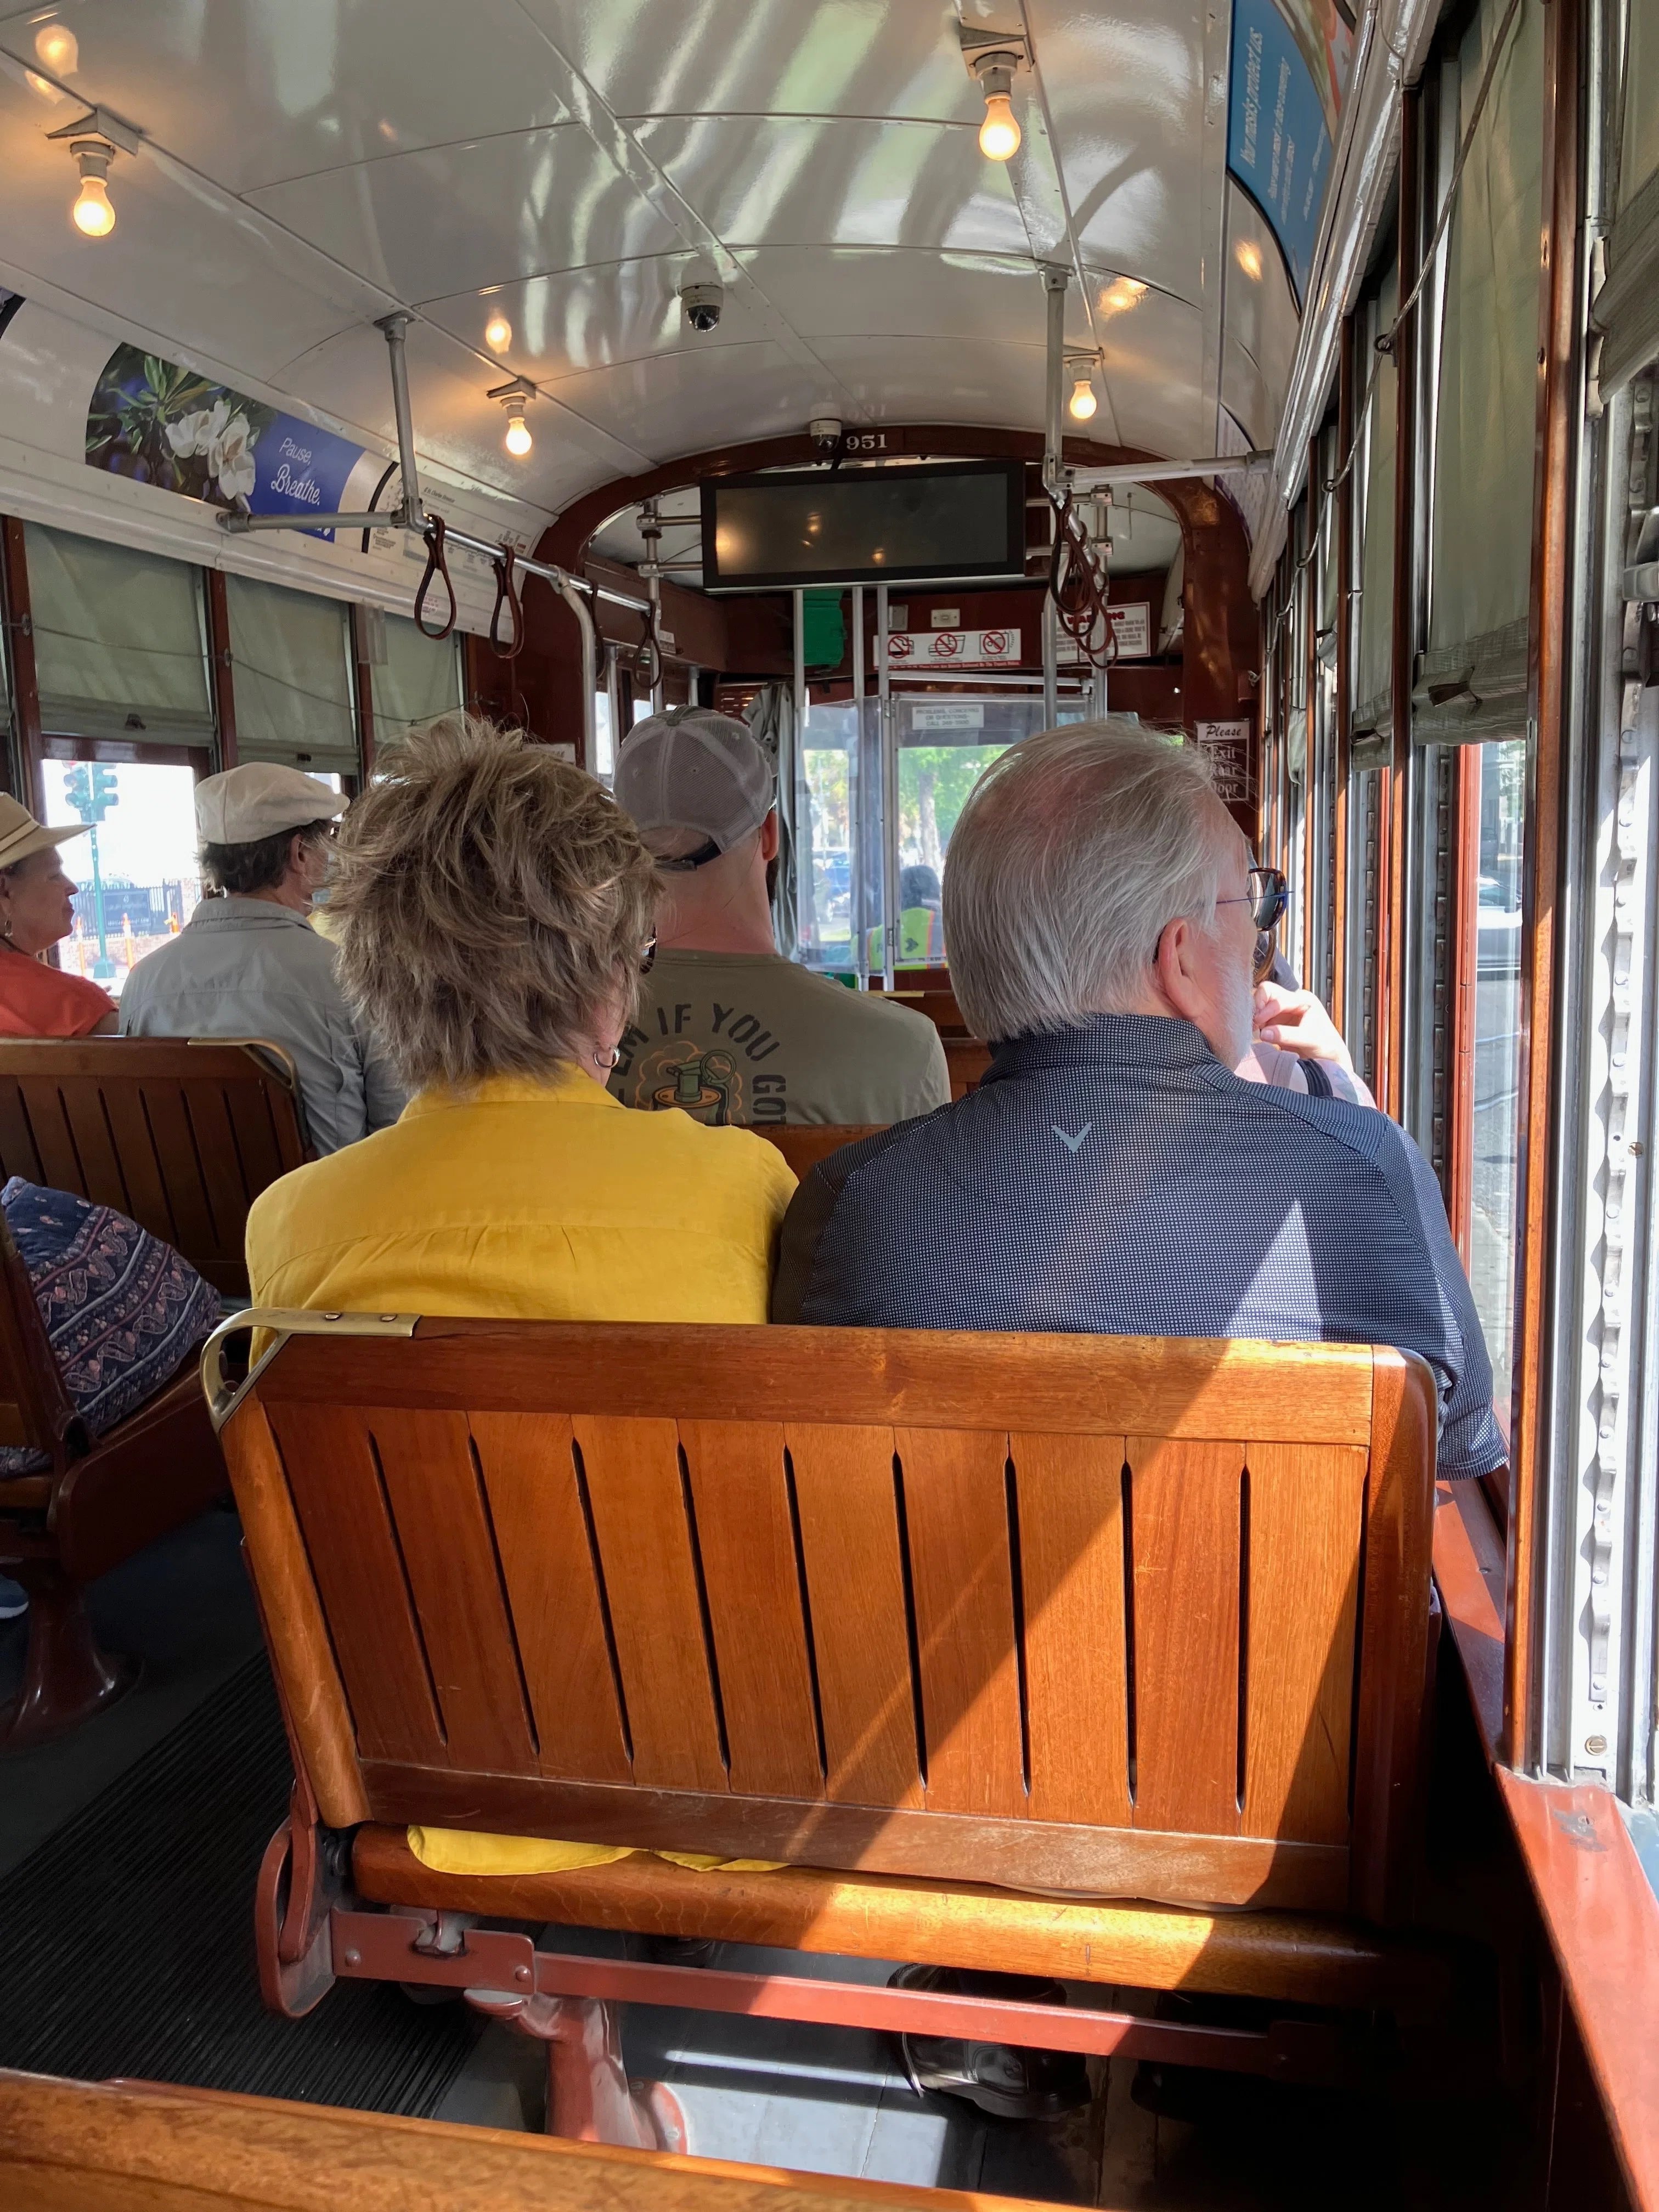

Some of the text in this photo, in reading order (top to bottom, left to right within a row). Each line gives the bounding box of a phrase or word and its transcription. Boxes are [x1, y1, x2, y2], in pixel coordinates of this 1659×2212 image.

[1245, 43, 1261, 110] protect
[1242, 97, 1257, 145] masks
[1240, 136, 1255, 168] Your
[279, 437, 312, 465] Pause,
[846, 434, 888, 450] 951
[270, 464, 320, 506] Breathe.
[1206, 725, 1242, 738] Please
[1211, 746, 1236, 759] Exit
[1210, 763, 1237, 777] Rear
[1210, 781, 1238, 794] Door
[657, 1003, 692, 1036] IF
[712, 1003, 780, 1062] YOU
